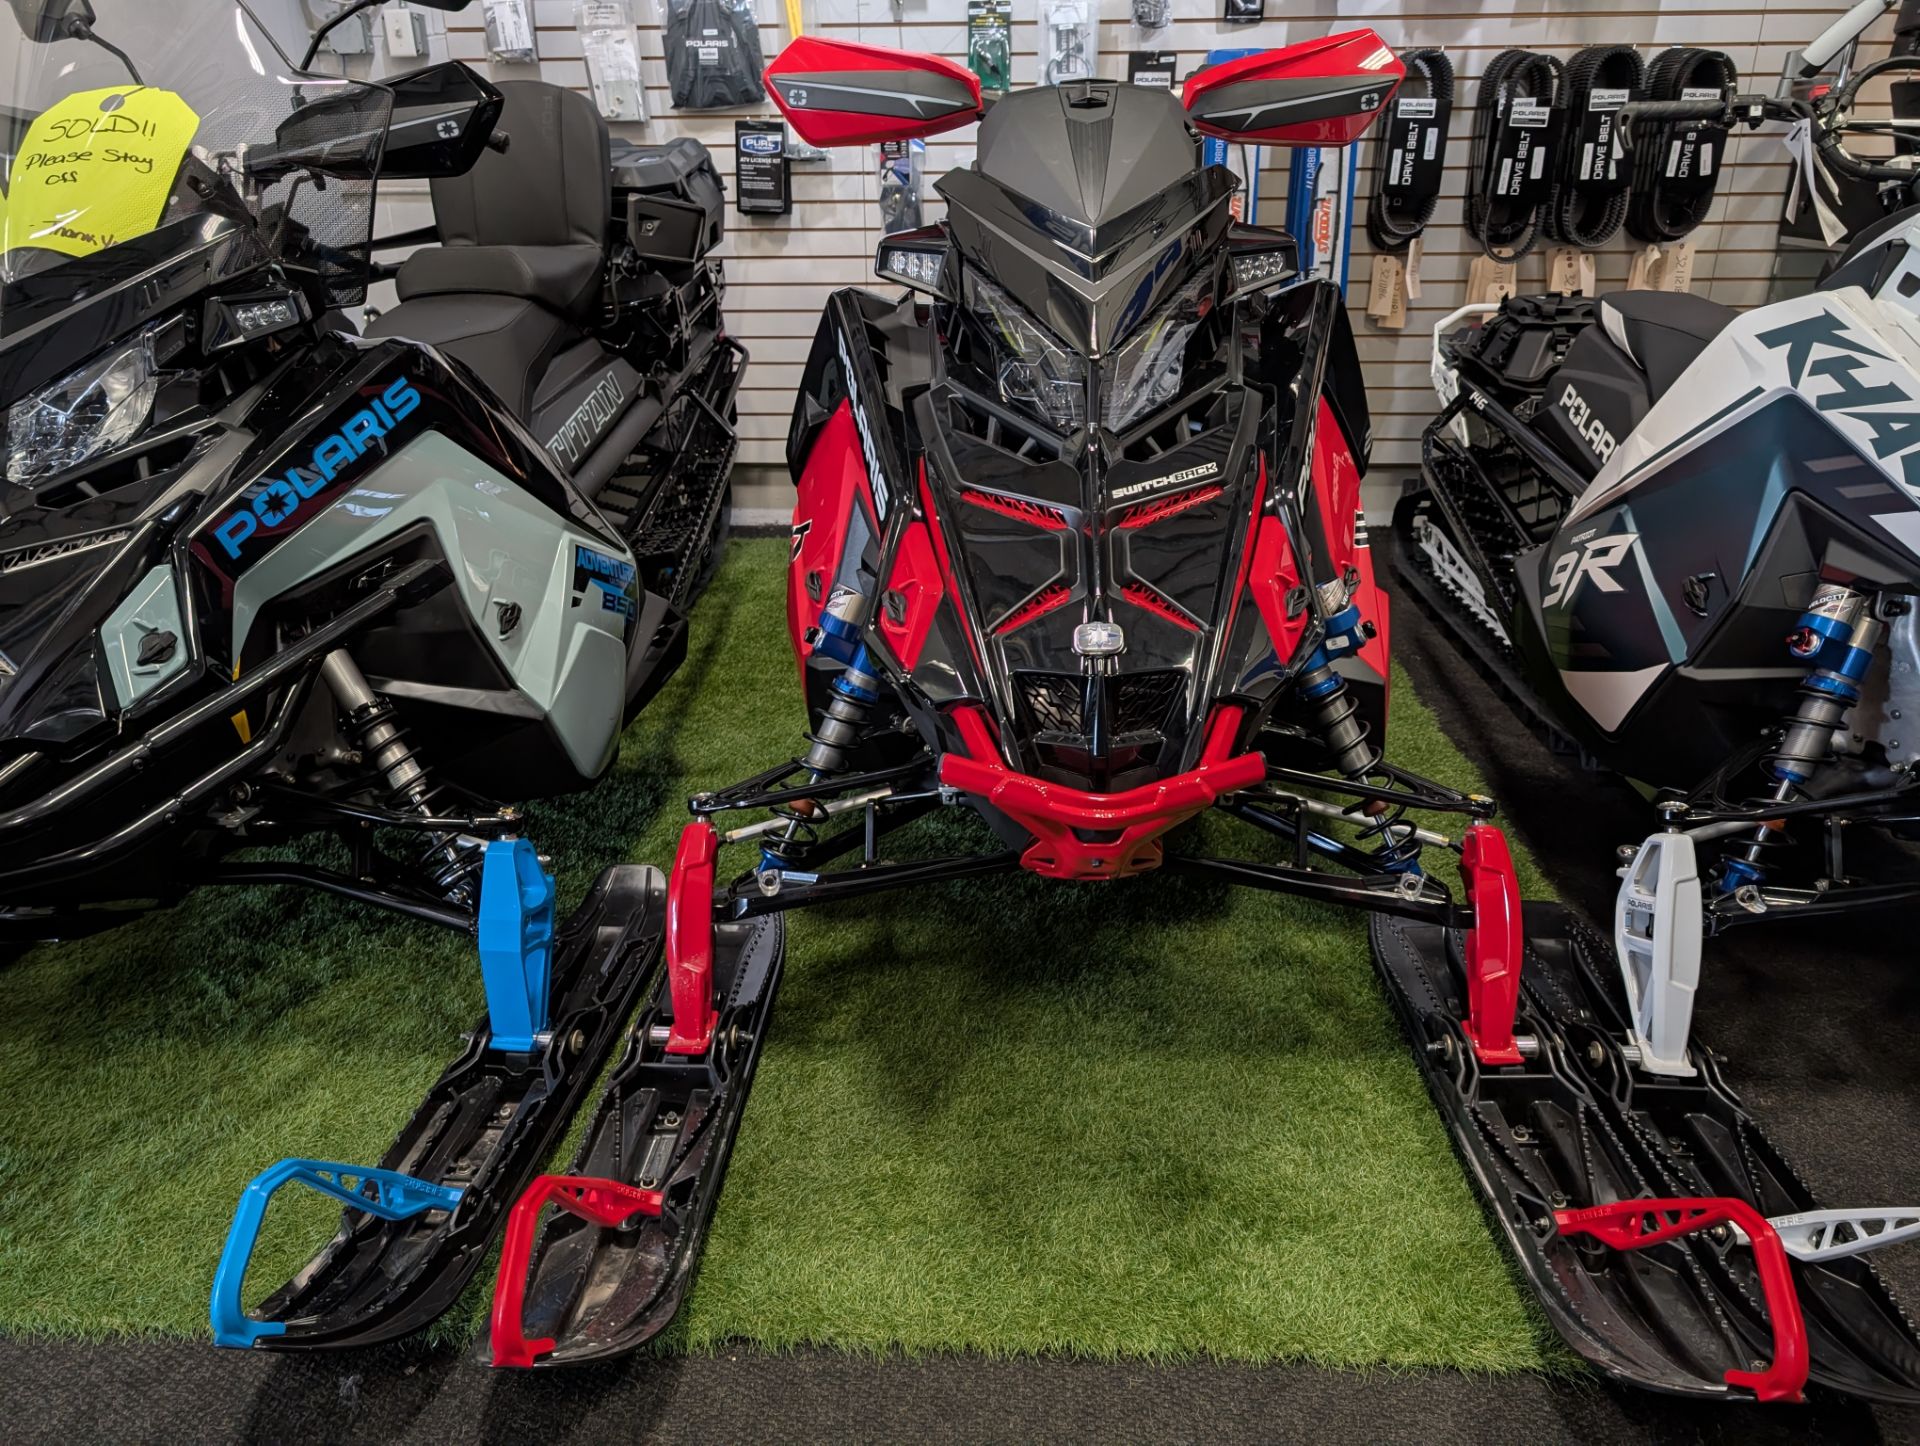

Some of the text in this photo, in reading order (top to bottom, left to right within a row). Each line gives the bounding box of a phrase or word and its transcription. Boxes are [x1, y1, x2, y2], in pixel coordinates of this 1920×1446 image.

[685, 39, 729, 48] POLARIS
[1406, 121, 1419, 150] BELT
[1517, 130, 1531, 159] BELT
[1598, 114, 1612, 143] BELT
[25, 148, 154, 174] Please Stay
[739, 156, 782, 165] ATV LICENSE KIT
[1306, 147, 1318, 180] CARBID
[1401, 151, 1416, 186] DRIVE
[1593, 145, 1608, 180] DRIVE
[1678, 143, 1695, 178] DRIVE
[1510, 161, 1526, 196] DRIVE
[1469, 391, 1489, 411] 146
[545, 370, 625, 468] TITAN
[838, 325, 889, 522] POLARIS
[1559, 383, 1621, 465] POLAR
[213, 376, 422, 560] POLARIS
[1111, 461, 1219, 499] SWITCHBACK
[1541, 533, 1640, 611] 9R
